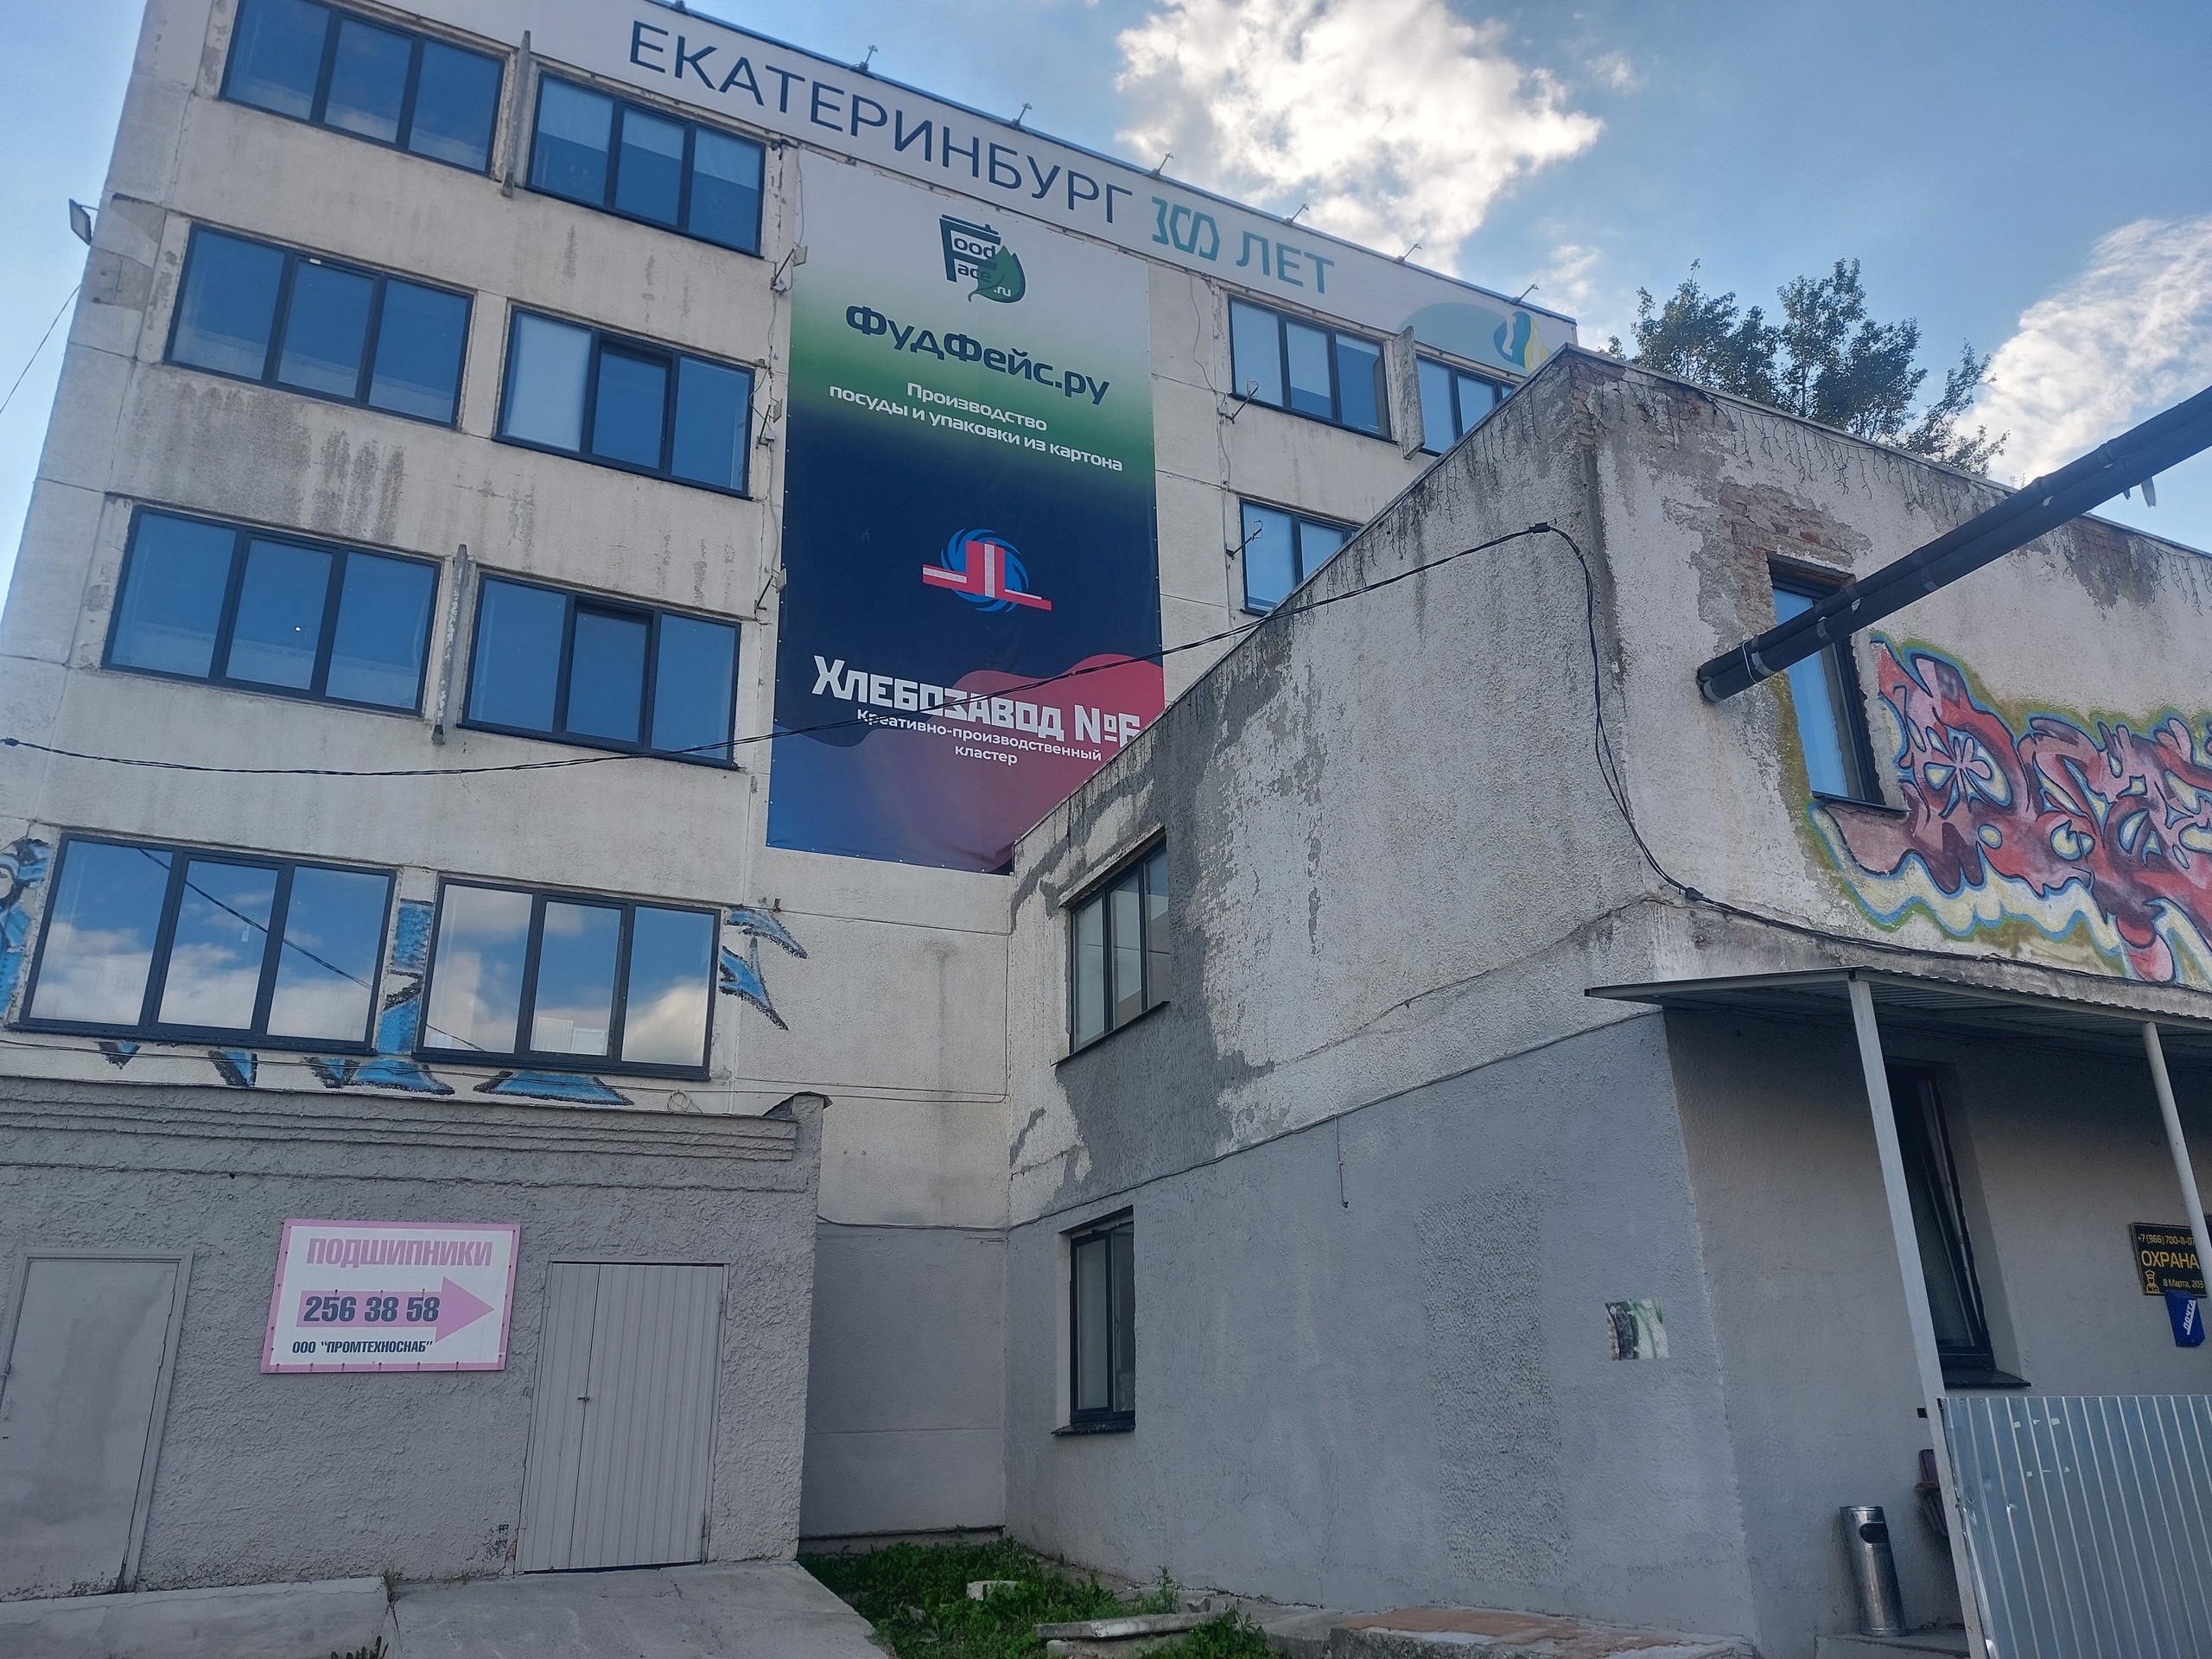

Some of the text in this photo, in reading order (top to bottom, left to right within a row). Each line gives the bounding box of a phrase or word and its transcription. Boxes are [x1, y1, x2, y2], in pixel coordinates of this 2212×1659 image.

[630, 21, 1133, 224] ЕКАТЕРИНБУРГ
[1236, 230, 1335, 295] ЛЕТ
[994, 286, 1011, 297] .ru
[845, 305, 1110, 405] ФудФейс.ру
[907, 382, 1048, 431] Производство
[830, 385, 1123, 472] посуды и упаковки из картона
[811, 654, 1065, 742] ХЛЕБОЗАВОД
[856, 709, 1103, 762] Креативно-производственный
[954, 745, 1018, 766] кластер
[306, 1237, 493, 1268] ПОДШИПНИКИ
[2141, 1250, 2200, 1269] ОХРАНА
[303, 1296, 441, 1322] 256 38 58
[2183, 1300, 2196, 1332] ПОЧТА
[292, 1340, 434, 1353] ООО "ПРОМТЕХНОСНАБ"
